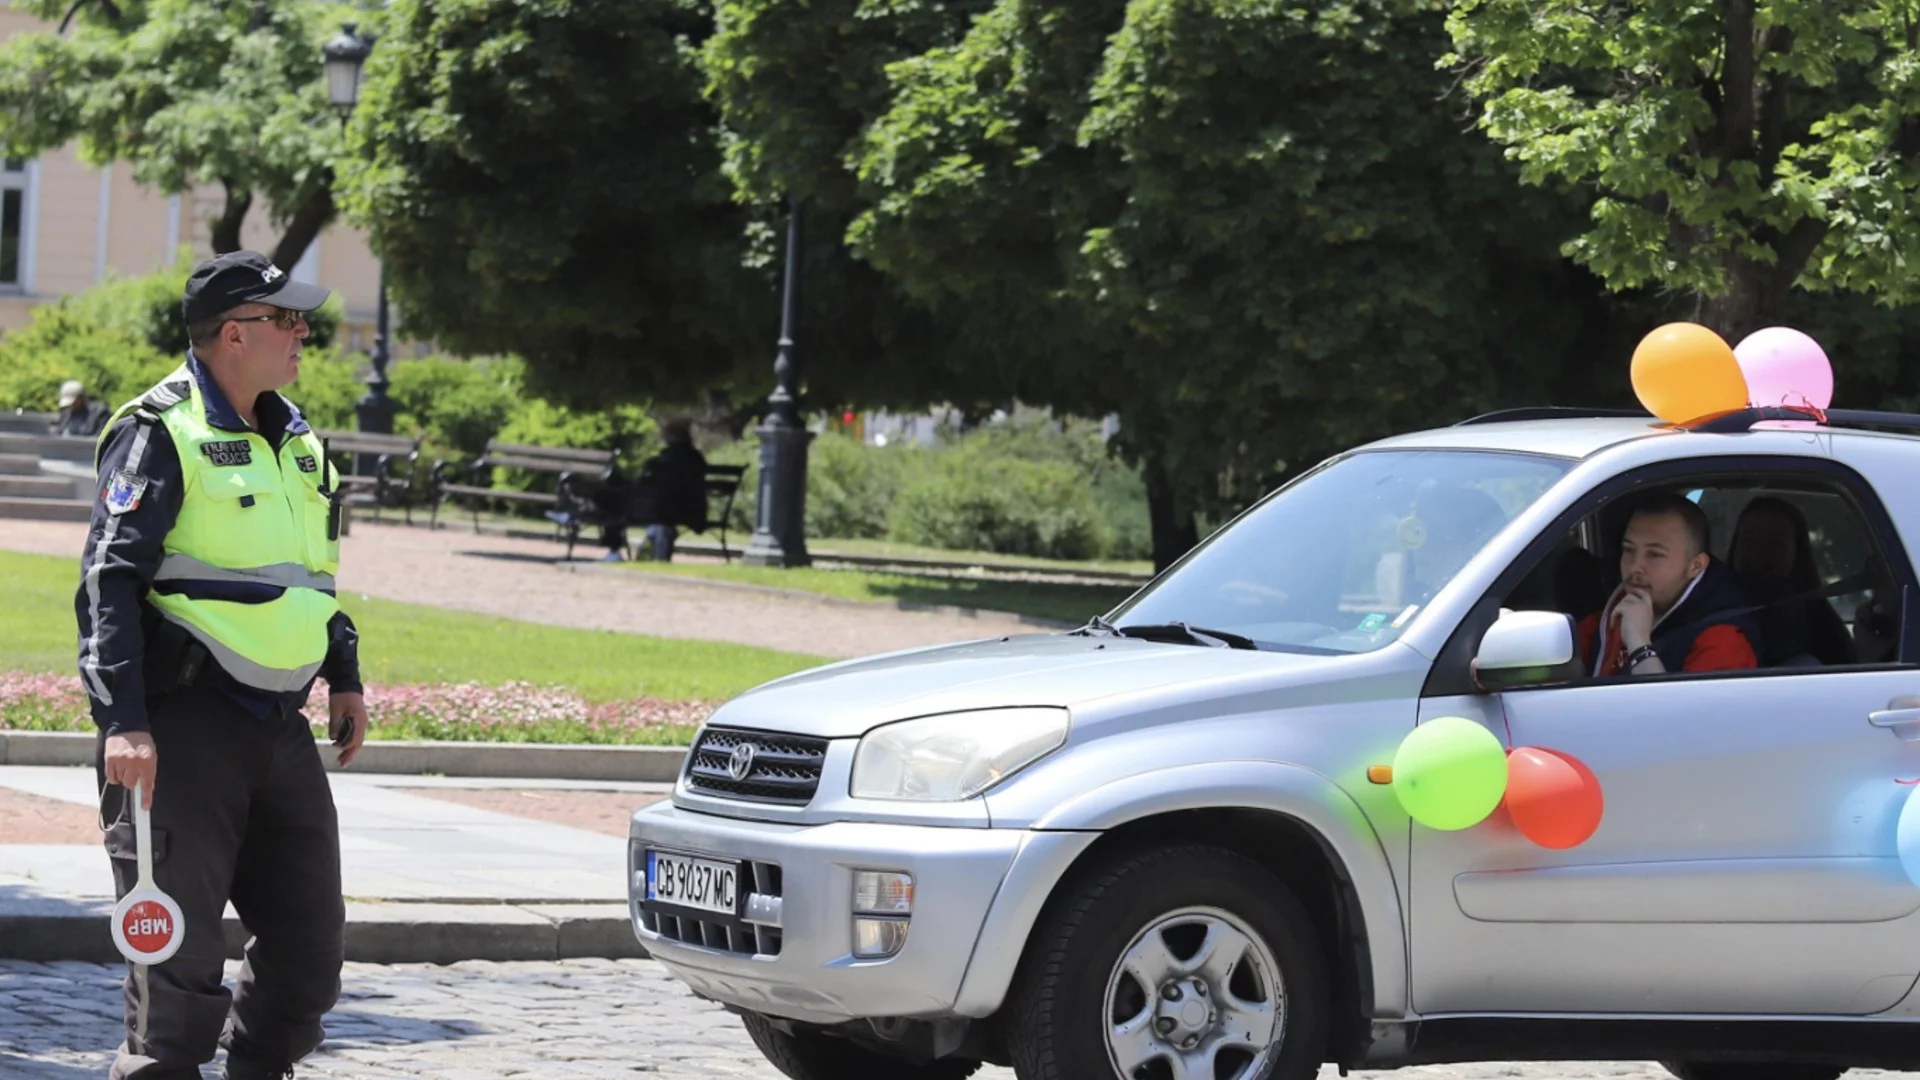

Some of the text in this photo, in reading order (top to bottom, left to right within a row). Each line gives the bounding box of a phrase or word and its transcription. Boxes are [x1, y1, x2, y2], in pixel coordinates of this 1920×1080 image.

[211, 452, 250, 465] POLICE
[657, 858, 735, 907] CB 9037 MC
